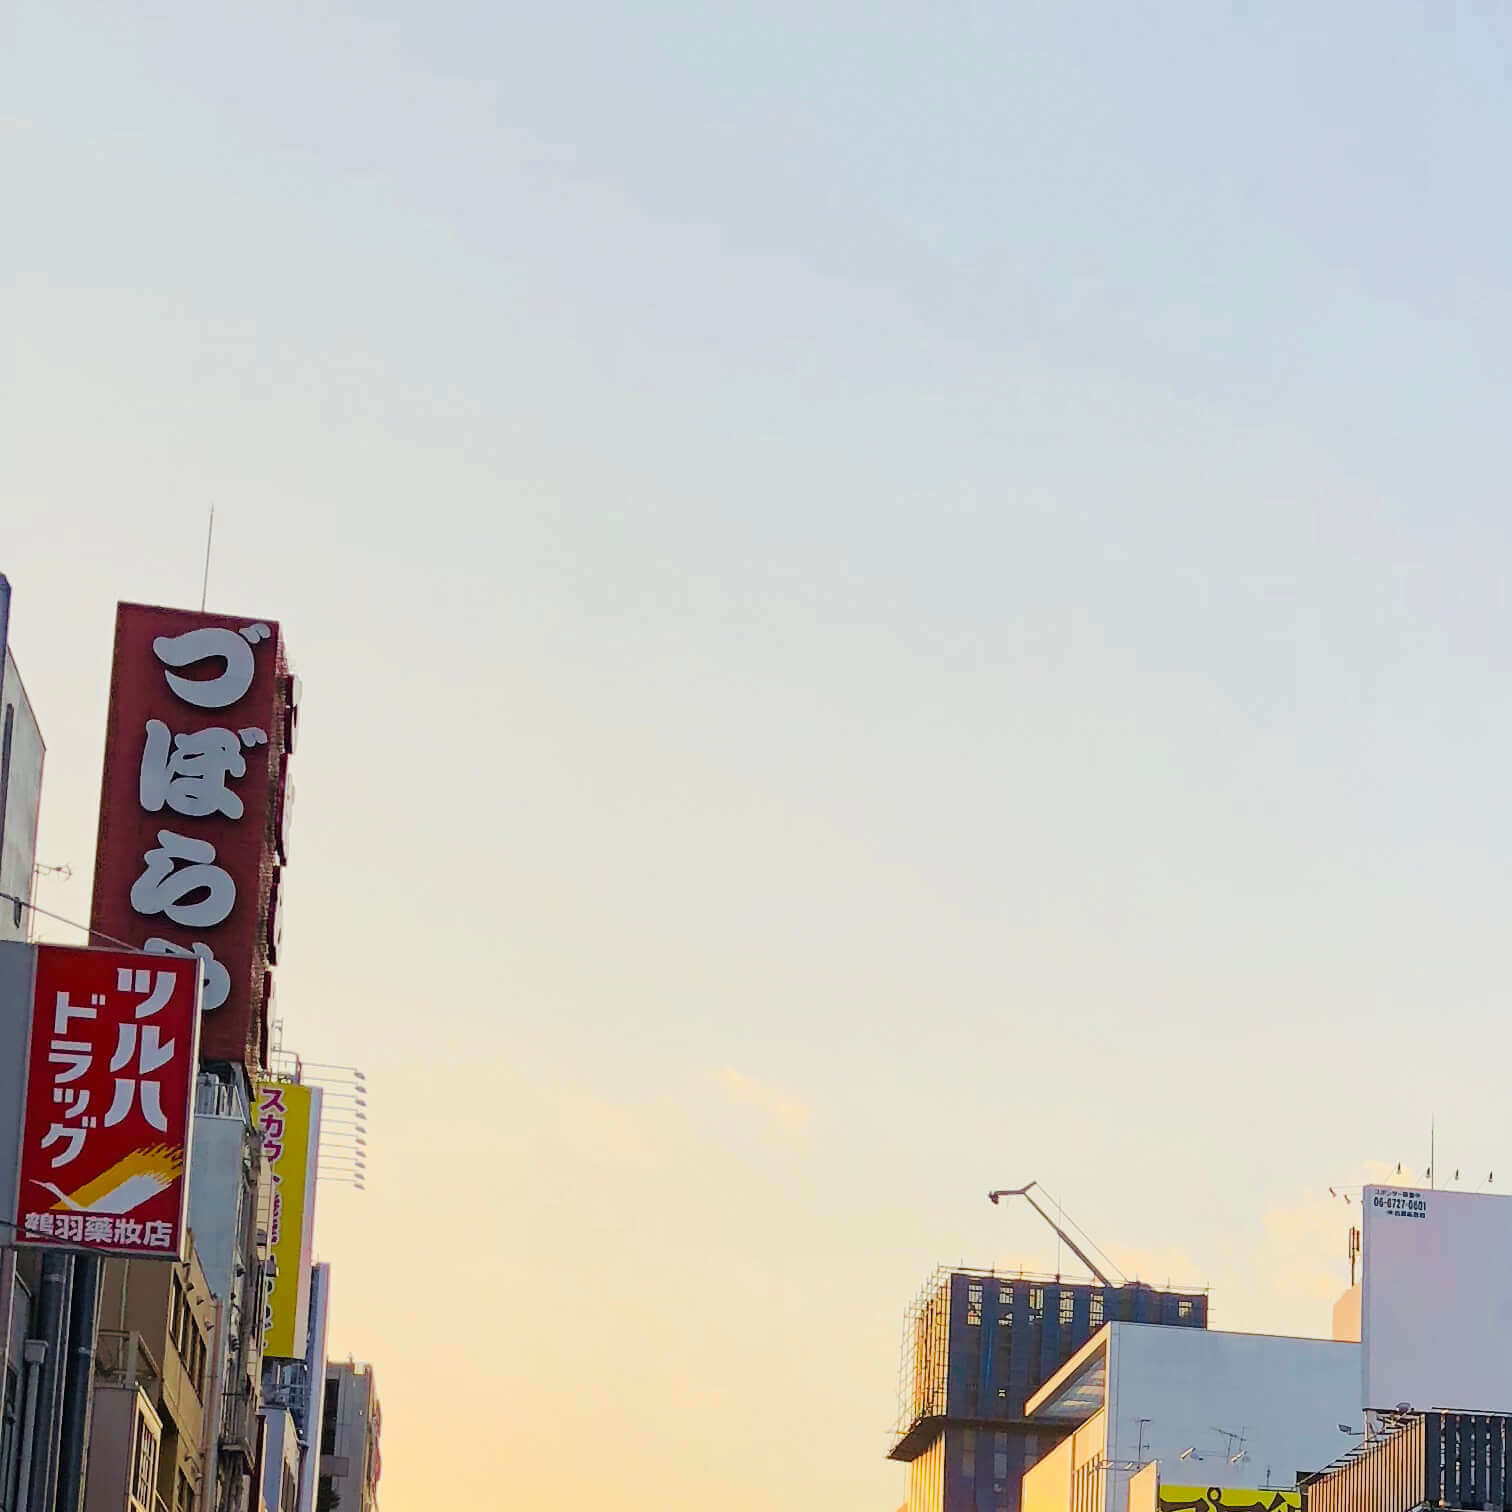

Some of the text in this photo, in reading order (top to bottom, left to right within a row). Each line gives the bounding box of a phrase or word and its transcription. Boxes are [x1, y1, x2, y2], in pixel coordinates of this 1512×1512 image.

[41, 990, 106, 1169] ドラッグ
[103, 967, 177, 1133] ツルハ
